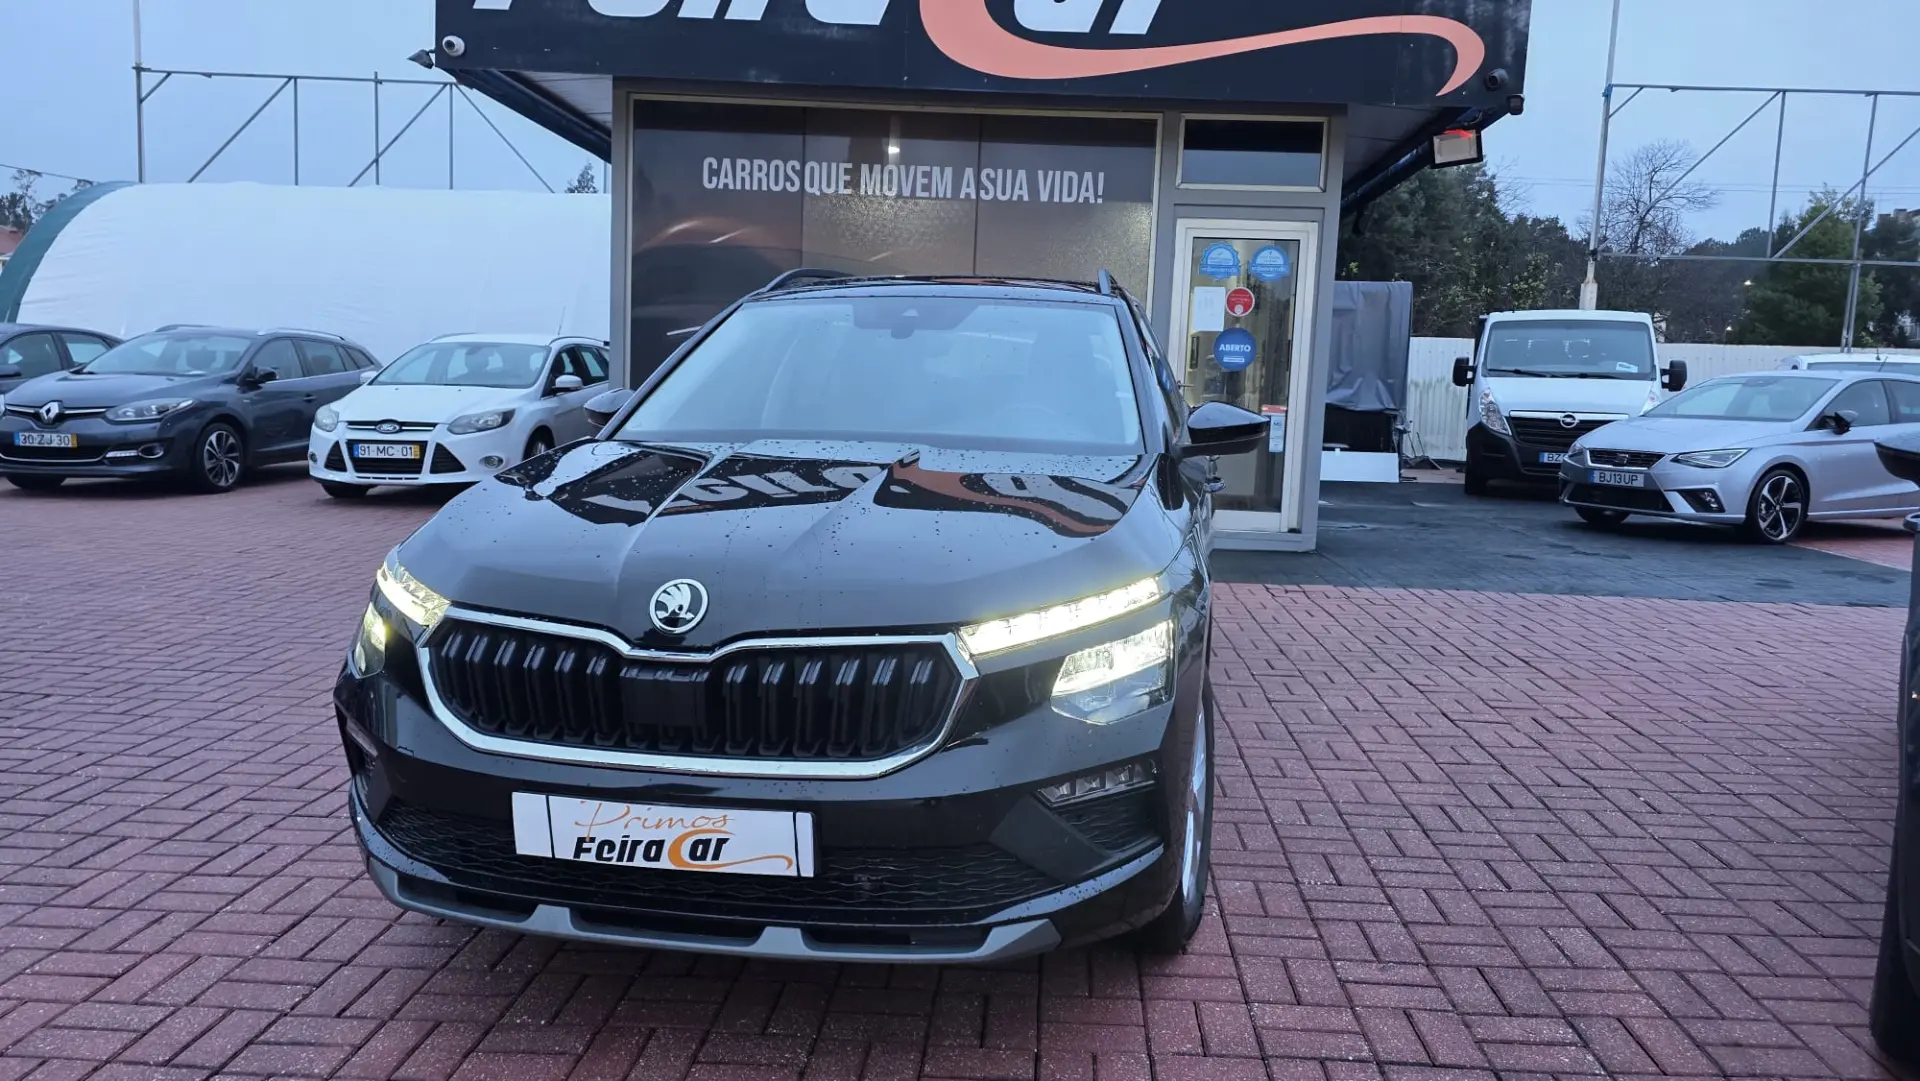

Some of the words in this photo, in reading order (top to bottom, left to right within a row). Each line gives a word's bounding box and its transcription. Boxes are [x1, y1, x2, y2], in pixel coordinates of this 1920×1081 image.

[702, 157, 801, 192] CARROS
[803, 160, 853, 197] QUE
[859, 163, 954, 199] MOVEM
[959, 167, 978, 200] A
[980, 168, 1031, 203] SUA
[1037, 170, 1105, 205] VIDA!
[1218, 343, 1252, 353] ABERTO
[574, 800, 735, 842] Primos
